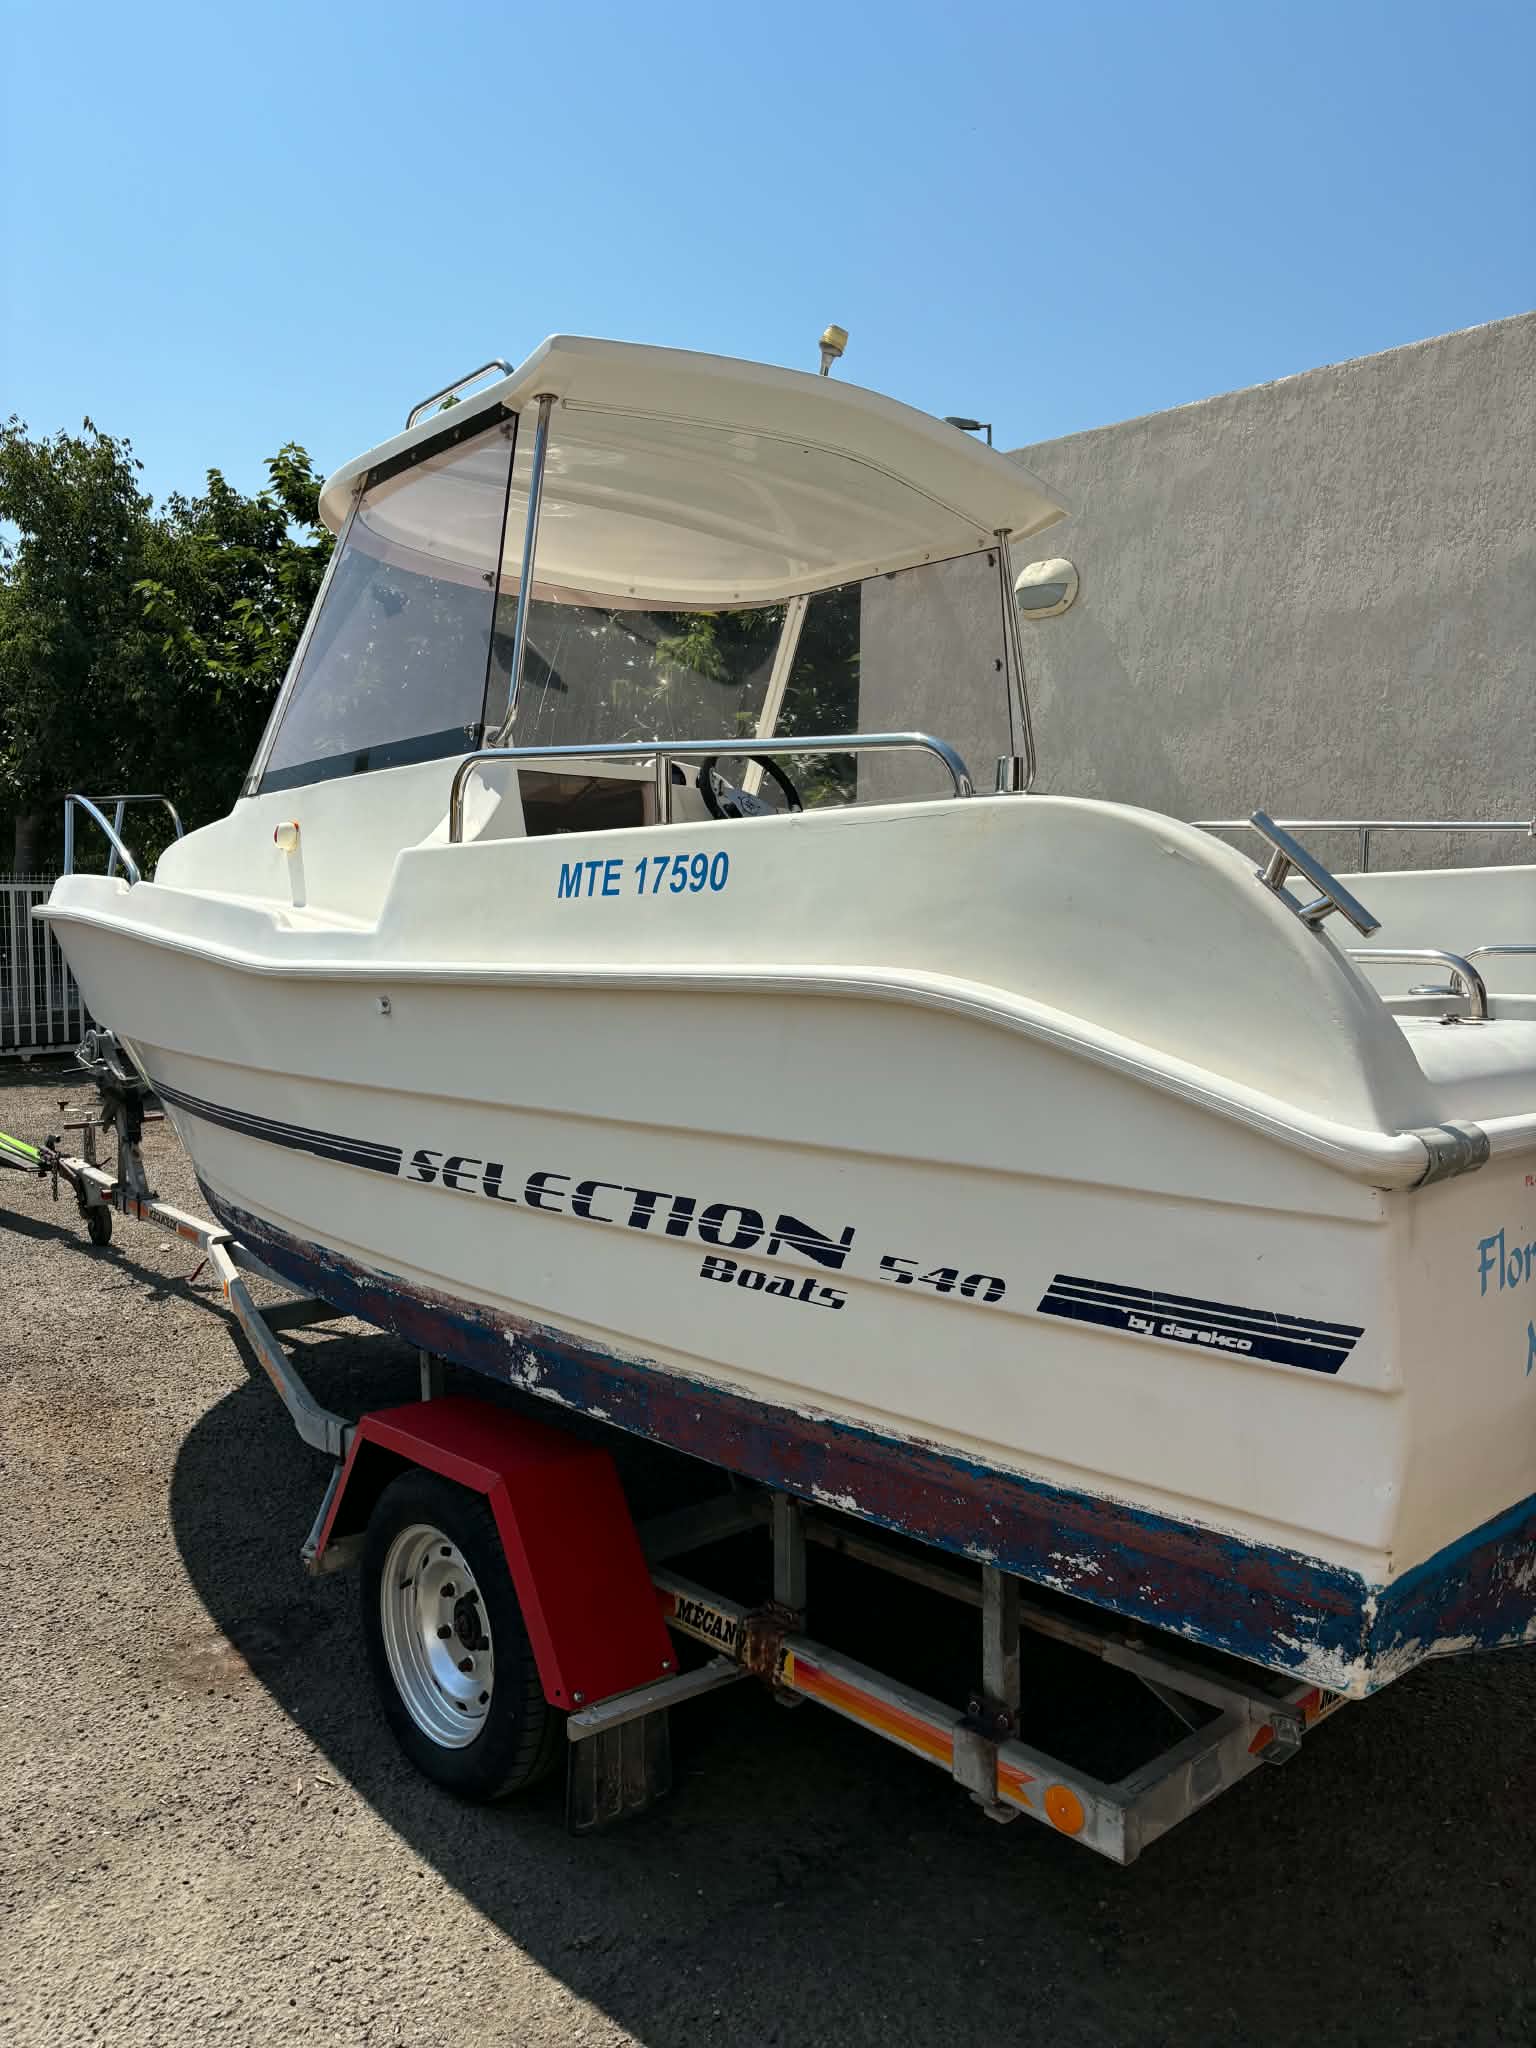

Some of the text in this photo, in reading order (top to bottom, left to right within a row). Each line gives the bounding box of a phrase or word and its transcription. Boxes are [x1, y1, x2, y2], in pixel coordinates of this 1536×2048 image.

[557, 851, 729, 898] MTE 17590
[406, 1149, 1006, 1302] SELECTION 540
[700, 1255, 848, 1309] Boats
[1128, 1315, 1155, 1335] by
